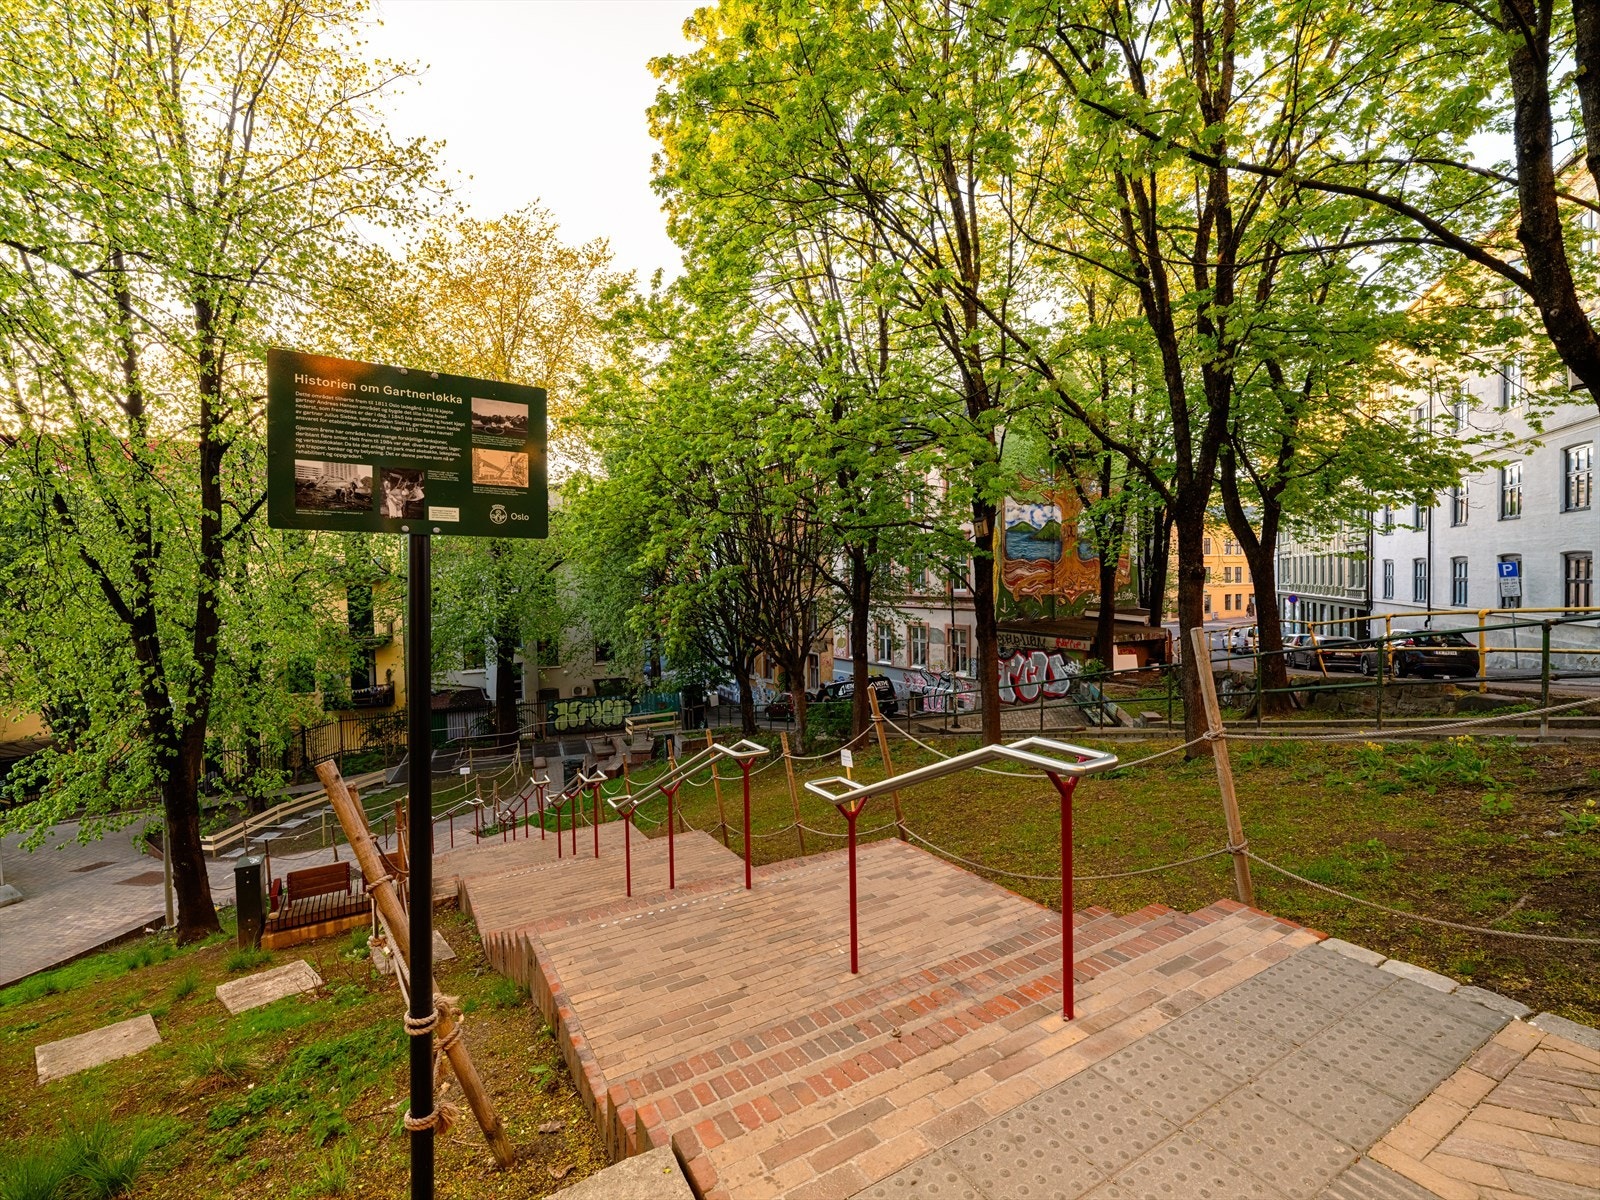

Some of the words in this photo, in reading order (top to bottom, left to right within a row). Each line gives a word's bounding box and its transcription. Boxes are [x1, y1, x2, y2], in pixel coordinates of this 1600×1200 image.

[294, 374, 356, 391] Historien
[360, 384, 379, 394] om
[383, 386, 462, 404] Gartnerløkka
[1502, 564, 1513, 576] P
